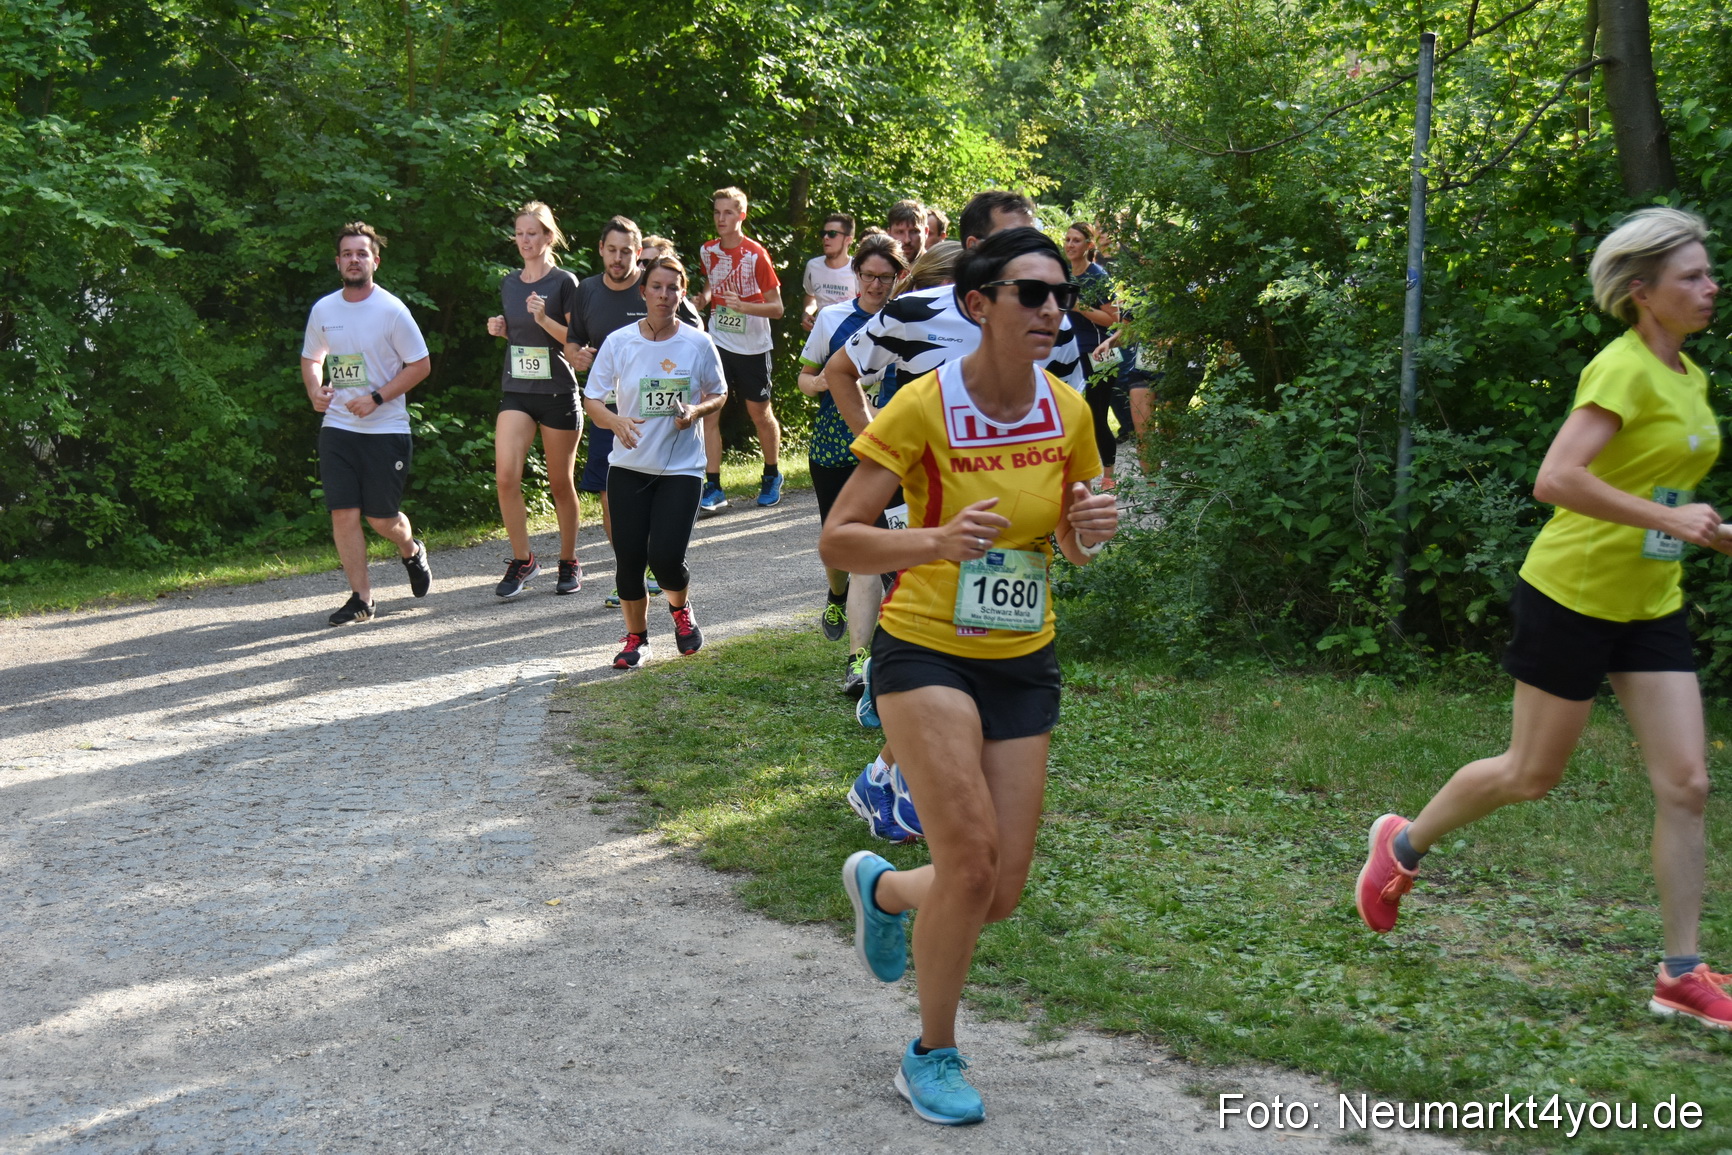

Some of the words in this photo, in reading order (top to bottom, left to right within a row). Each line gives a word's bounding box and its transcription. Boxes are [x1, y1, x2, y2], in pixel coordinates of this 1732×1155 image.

[718, 314, 741, 327] 2222
[519, 358, 540, 371] 159
[332, 366, 360, 379] 2147
[646, 391, 683, 406] 1371
[950, 455, 1005, 473] MAX
[1011, 446, 1067, 469] BÖGL
[973, 575, 1038, 609] 1680
[980, 606, 1012, 616] Schwarz
[1014, 609, 1031, 617] Maria
